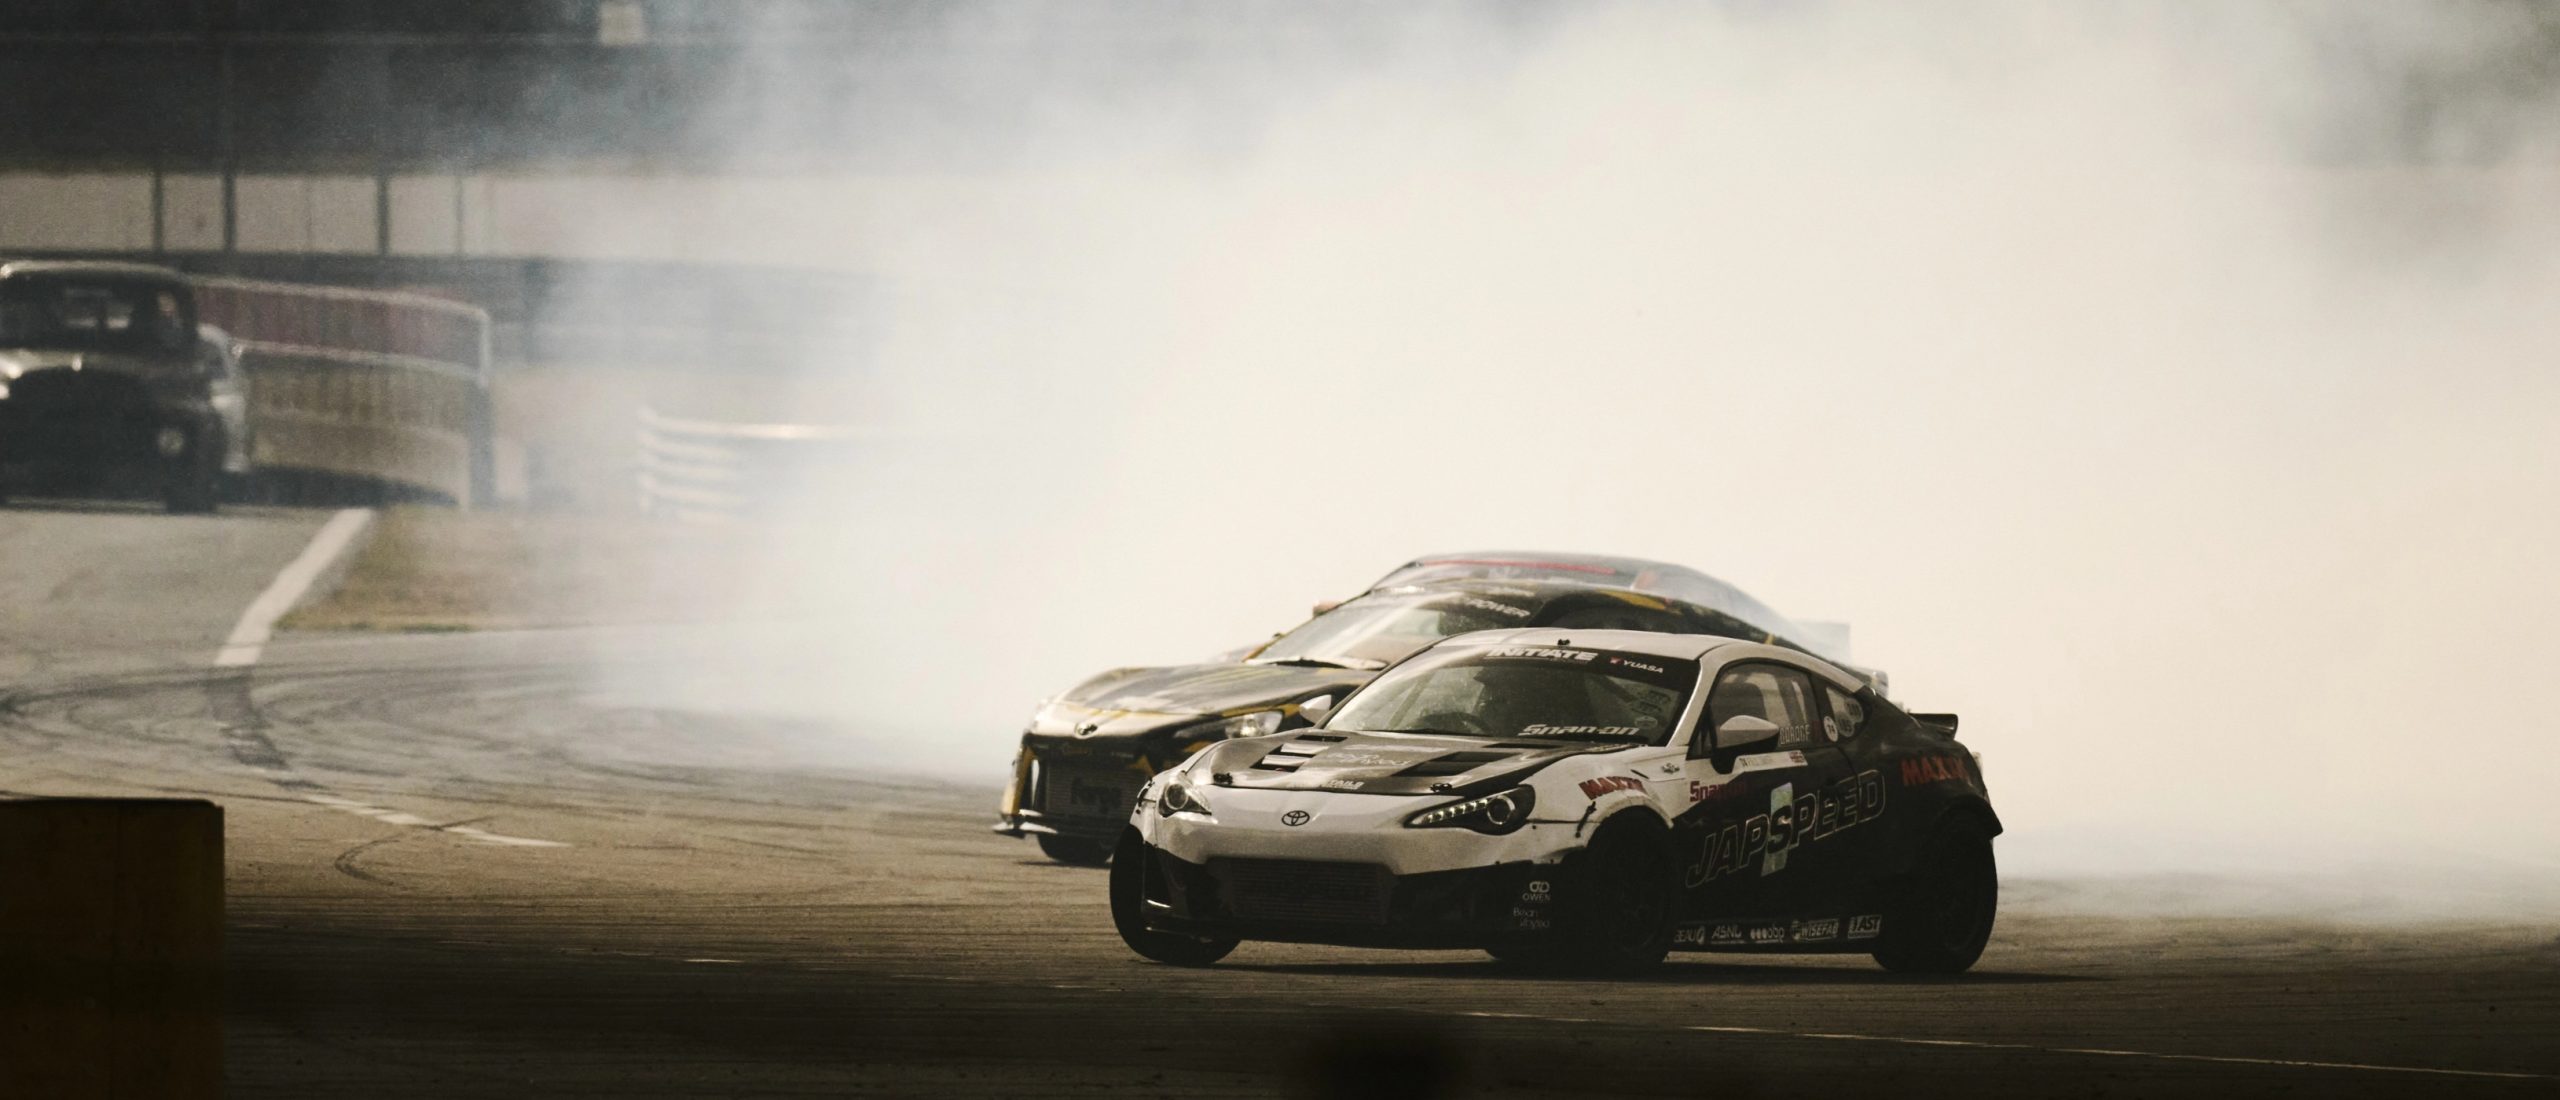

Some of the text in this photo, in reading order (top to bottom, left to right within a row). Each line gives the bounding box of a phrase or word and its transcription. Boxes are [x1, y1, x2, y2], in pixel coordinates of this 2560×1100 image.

[1485, 648, 1599, 662] INITIATE
[1623, 660, 1664, 674] YUASA
[1685, 769, 1887, 888] JAPSPEED
